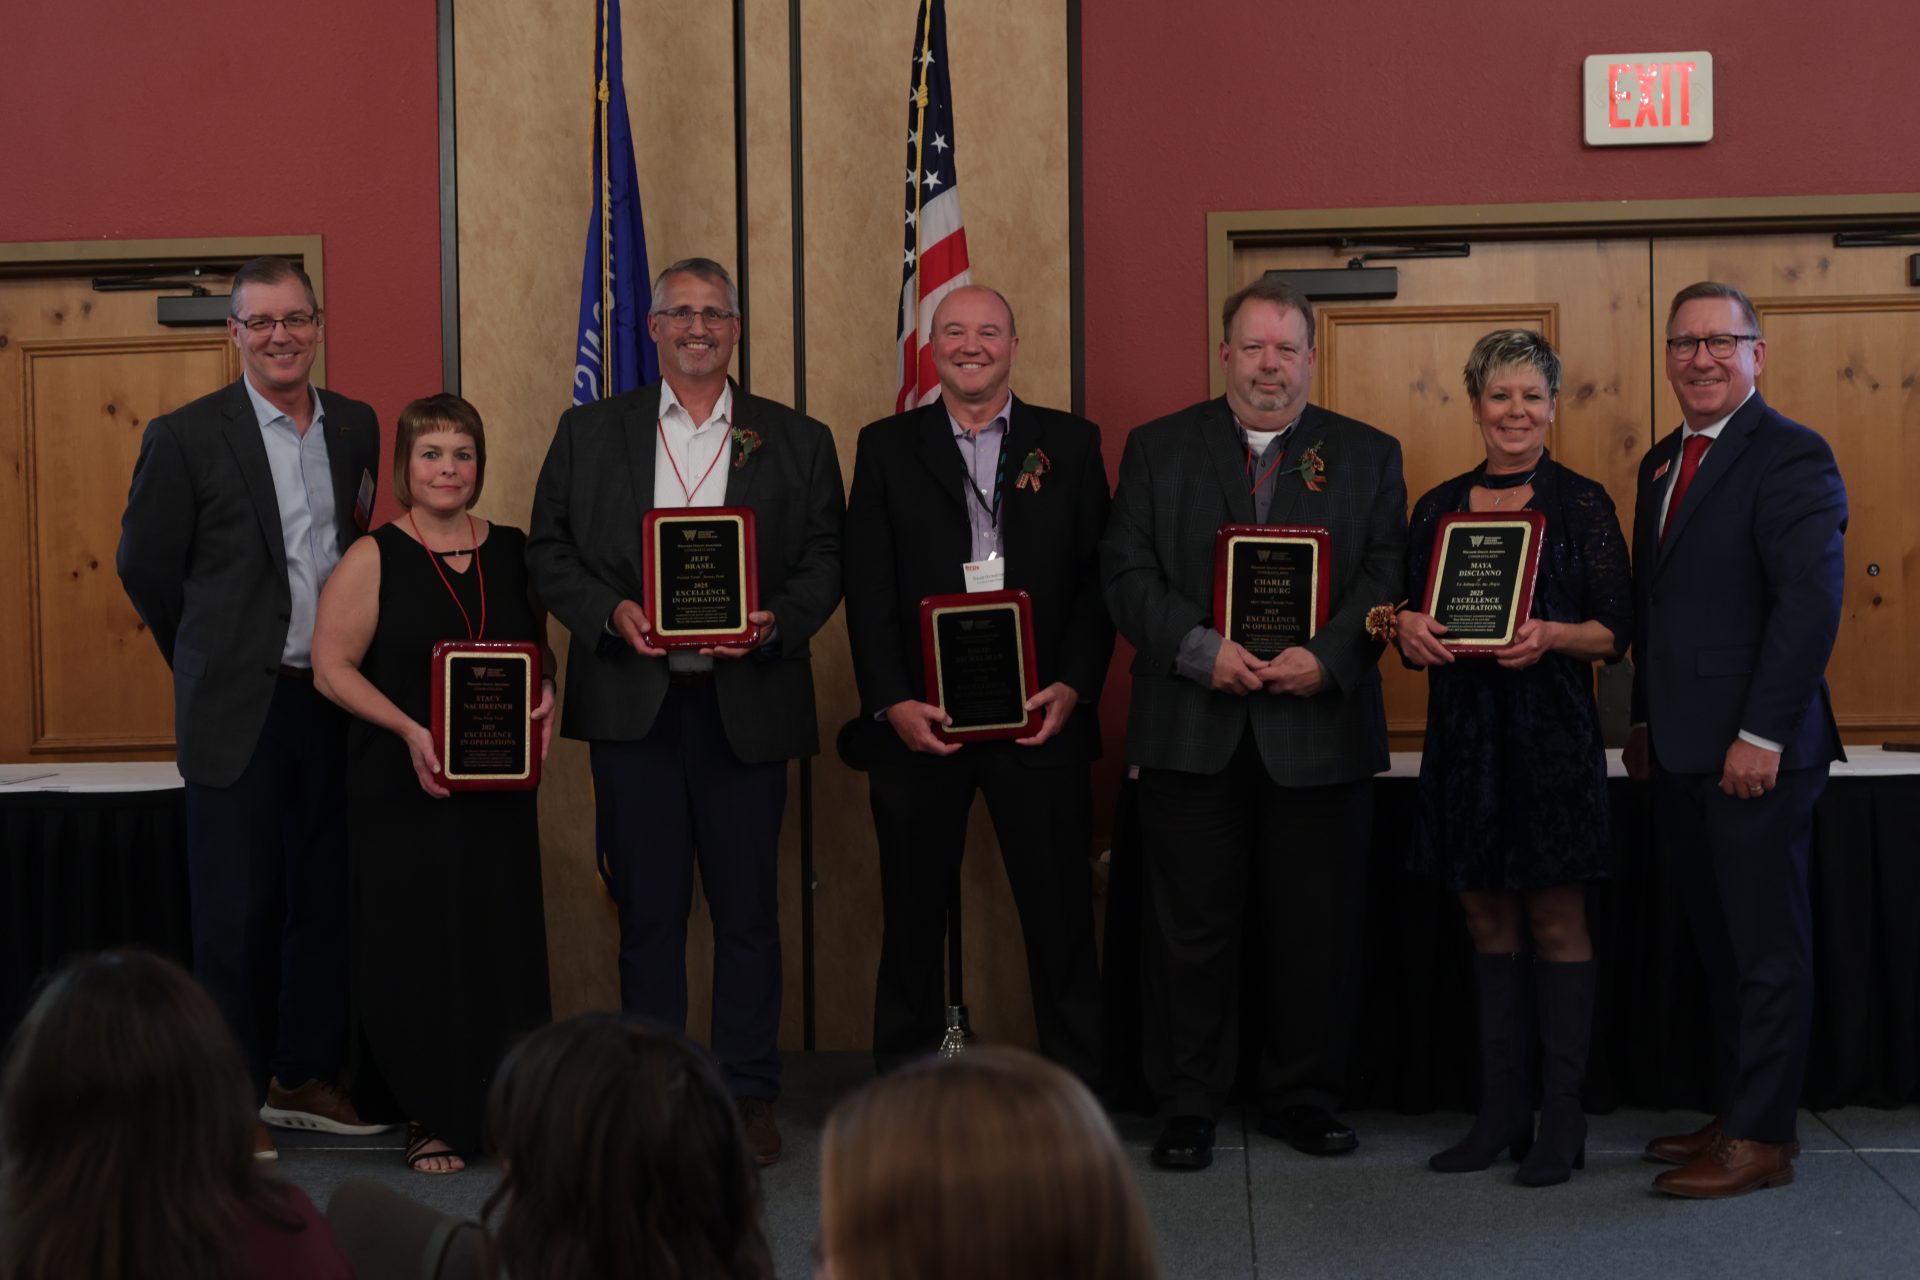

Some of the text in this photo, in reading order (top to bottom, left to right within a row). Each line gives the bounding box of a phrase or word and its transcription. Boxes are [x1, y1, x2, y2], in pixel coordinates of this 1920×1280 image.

[1608, 62, 1696, 128] EXIT
[1254, 578, 1291, 586] CHARLIE
[675, 588, 727, 597] EXCELLENCE
[1254, 586, 1291, 595] KILBURG
[1469, 589, 1484, 597] 2025
[682, 596, 731, 604] OPERATIONS
[1451, 596, 1500, 604] EXCELLENCE
[1246, 615, 1297, 623] EXCELLENCE
[1252, 623, 1301, 632] OPERATIONS
[463, 703, 513, 711] NACHREINER
[464, 731, 513, 739] EXCELLENCE
[460, 738, 517, 746] IN OPERATIONS
